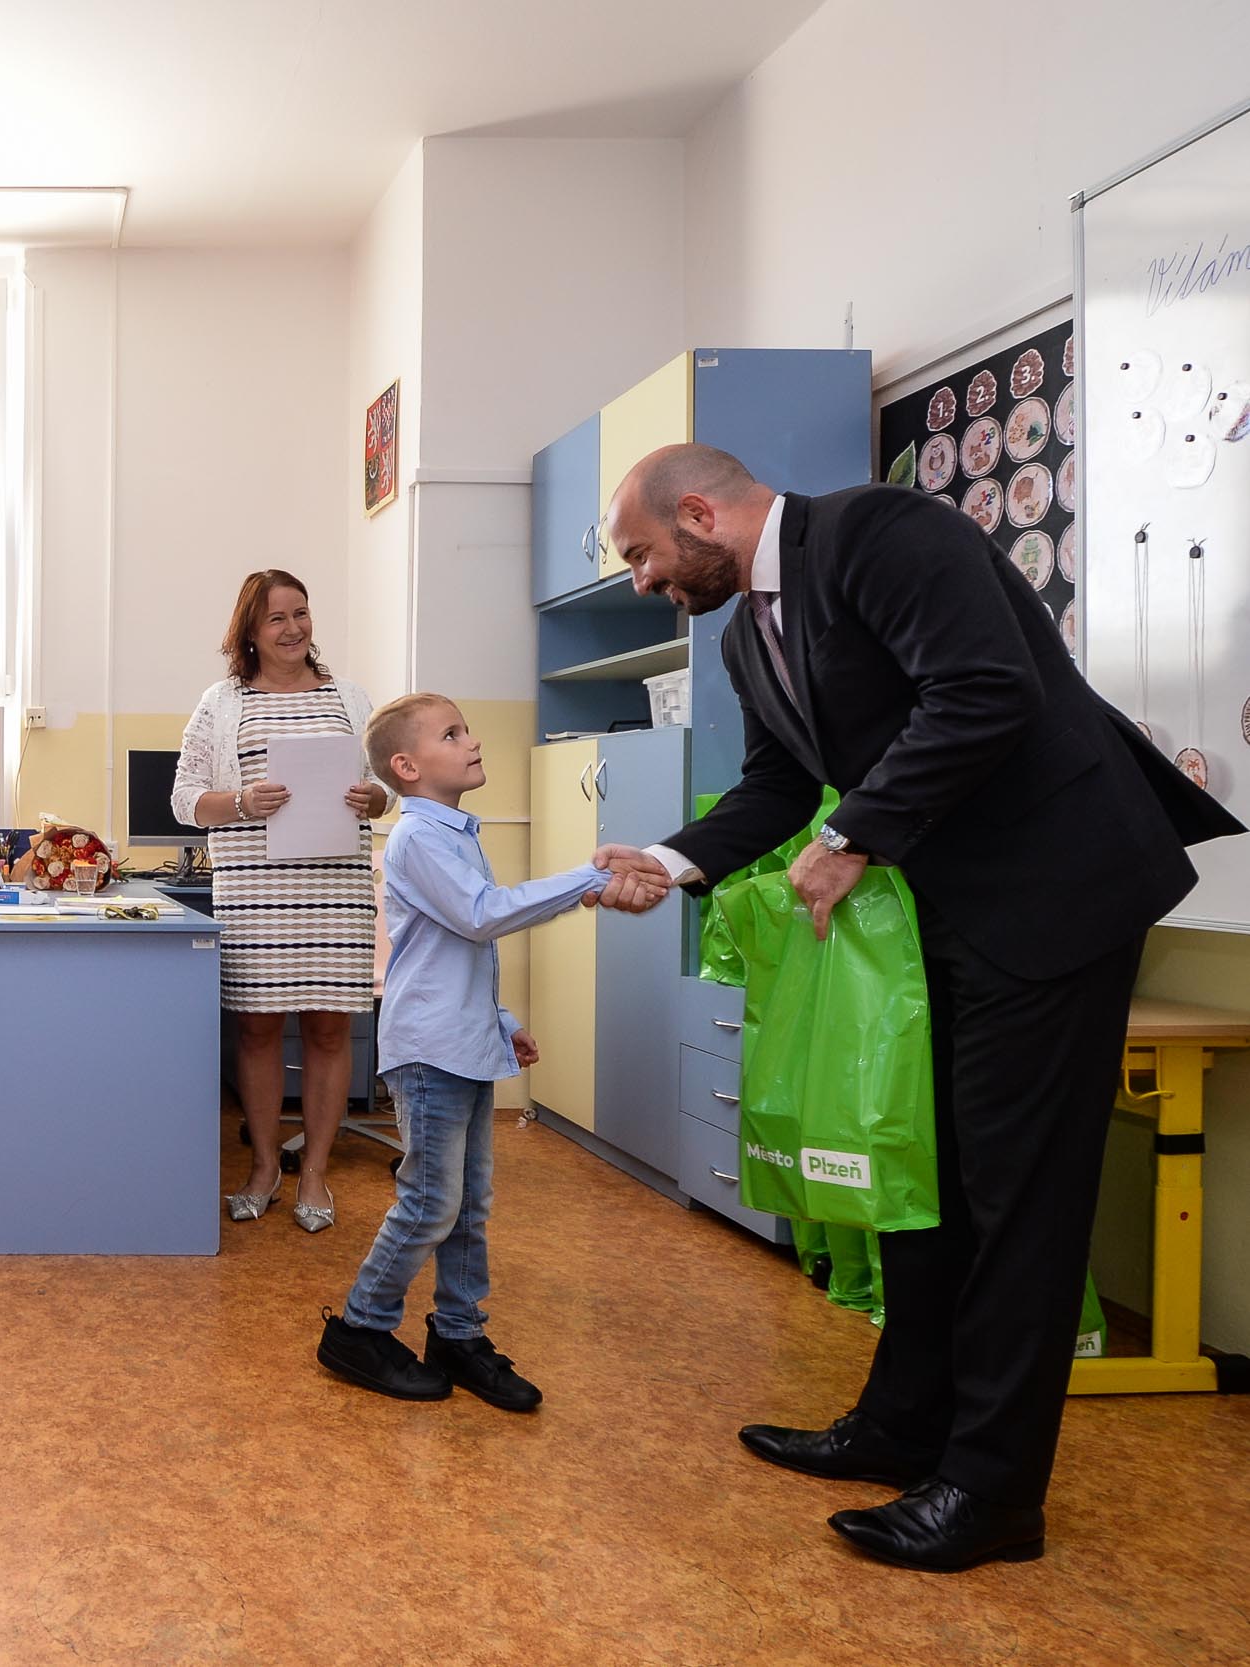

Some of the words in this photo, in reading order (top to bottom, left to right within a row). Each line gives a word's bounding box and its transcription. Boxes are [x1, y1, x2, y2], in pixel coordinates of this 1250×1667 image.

[1021, 365, 1036, 384] 3.
[976, 386, 990, 403] 2.
[937, 402, 949, 418] 1.
[746, 1142, 794, 1169] Město
[808, 1155, 863, 1180] Plzeň
